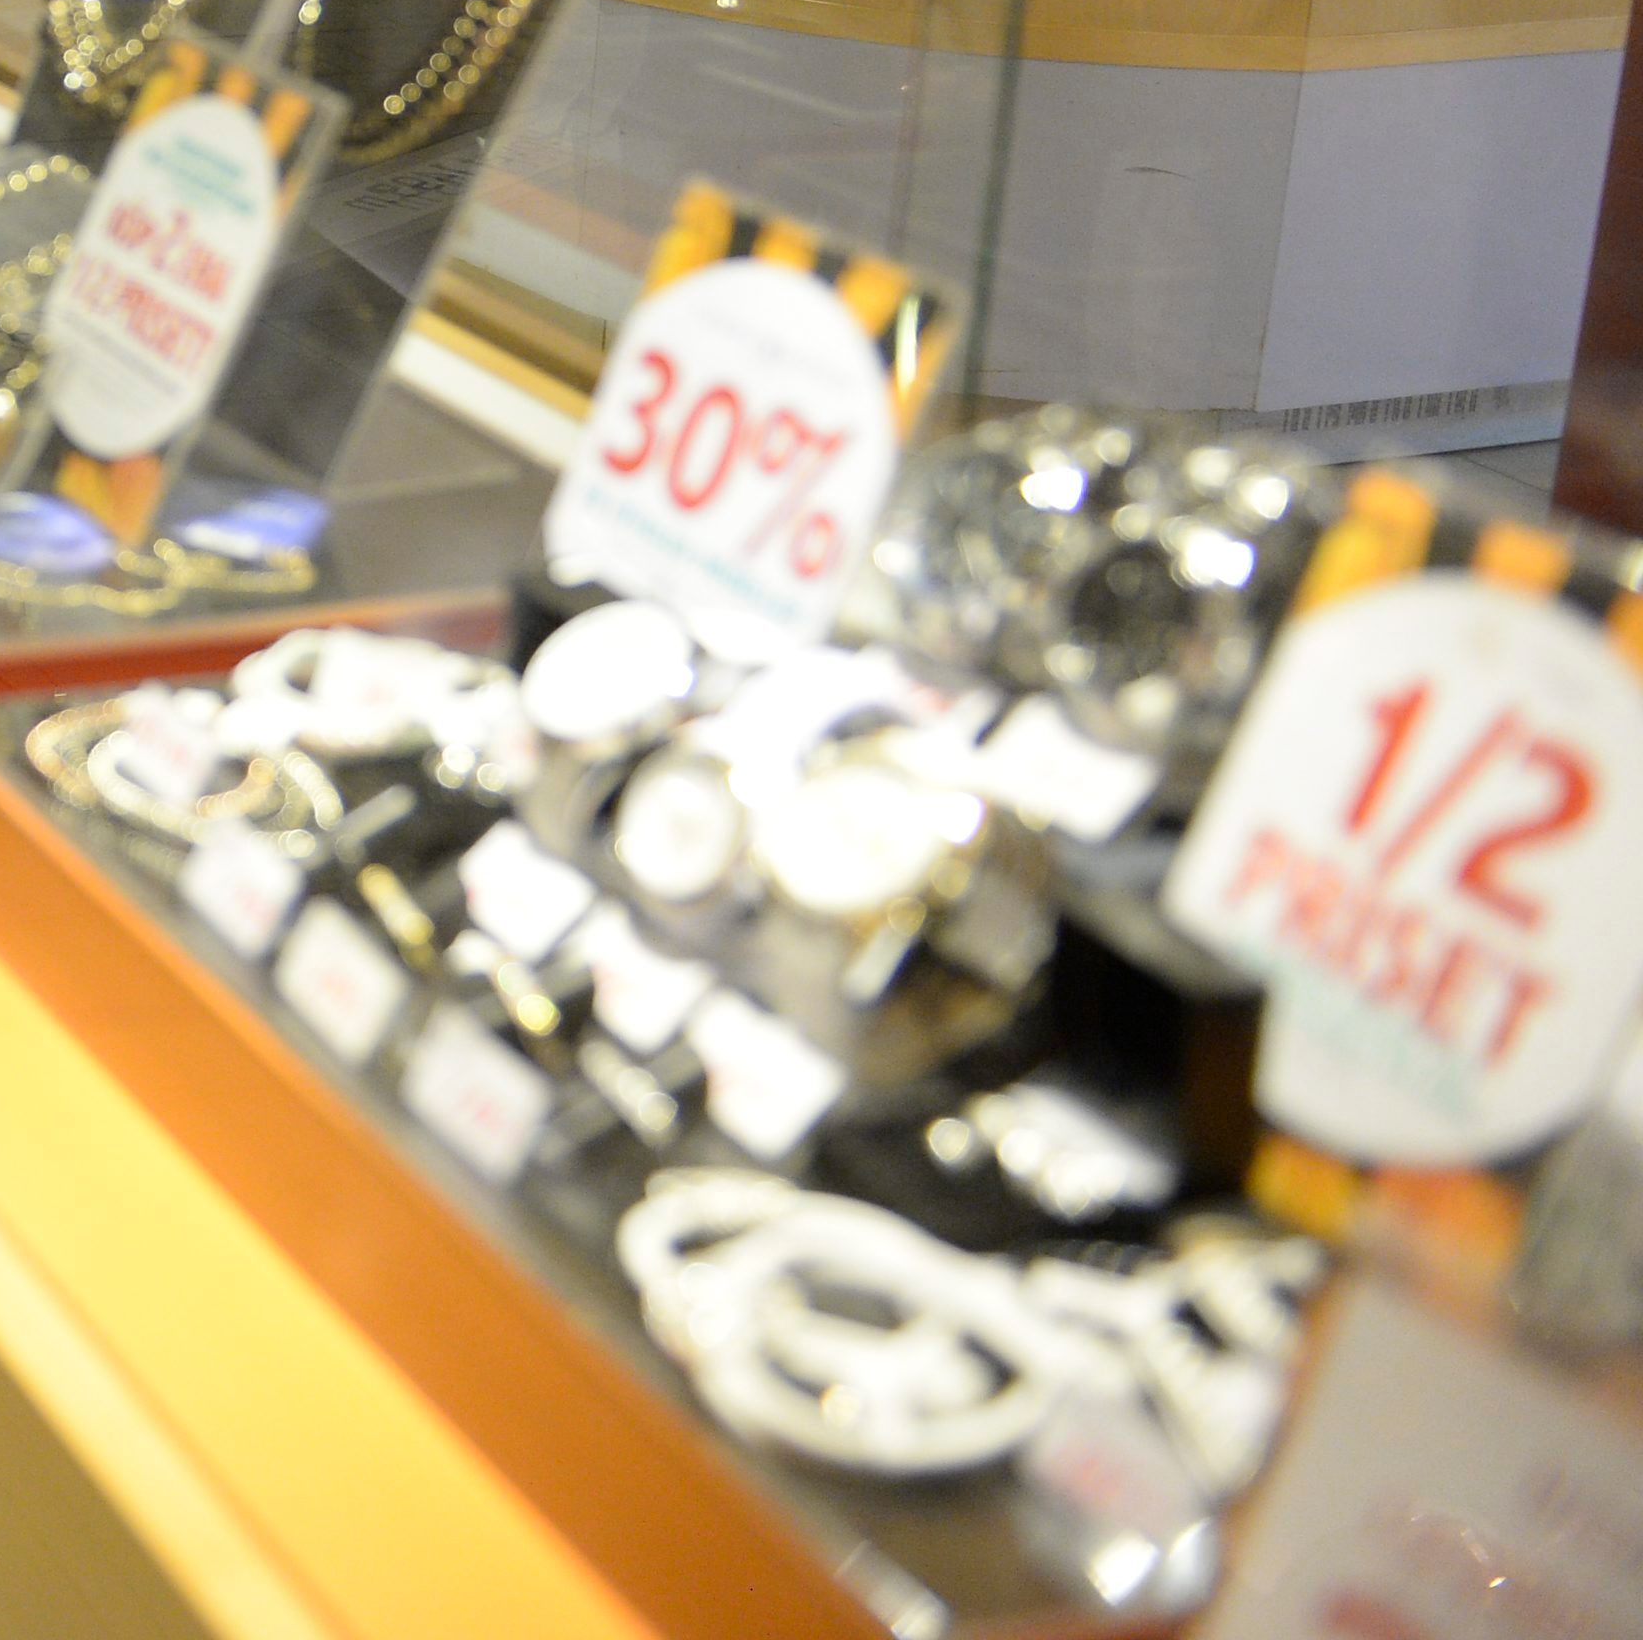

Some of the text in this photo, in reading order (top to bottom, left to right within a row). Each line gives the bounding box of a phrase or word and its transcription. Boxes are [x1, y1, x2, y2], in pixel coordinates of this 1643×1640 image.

[601, 348, 848, 580] 30%
[1344, 676, 1597, 934] 1/2
[1223, 828, 1555, 1069] PRISET
